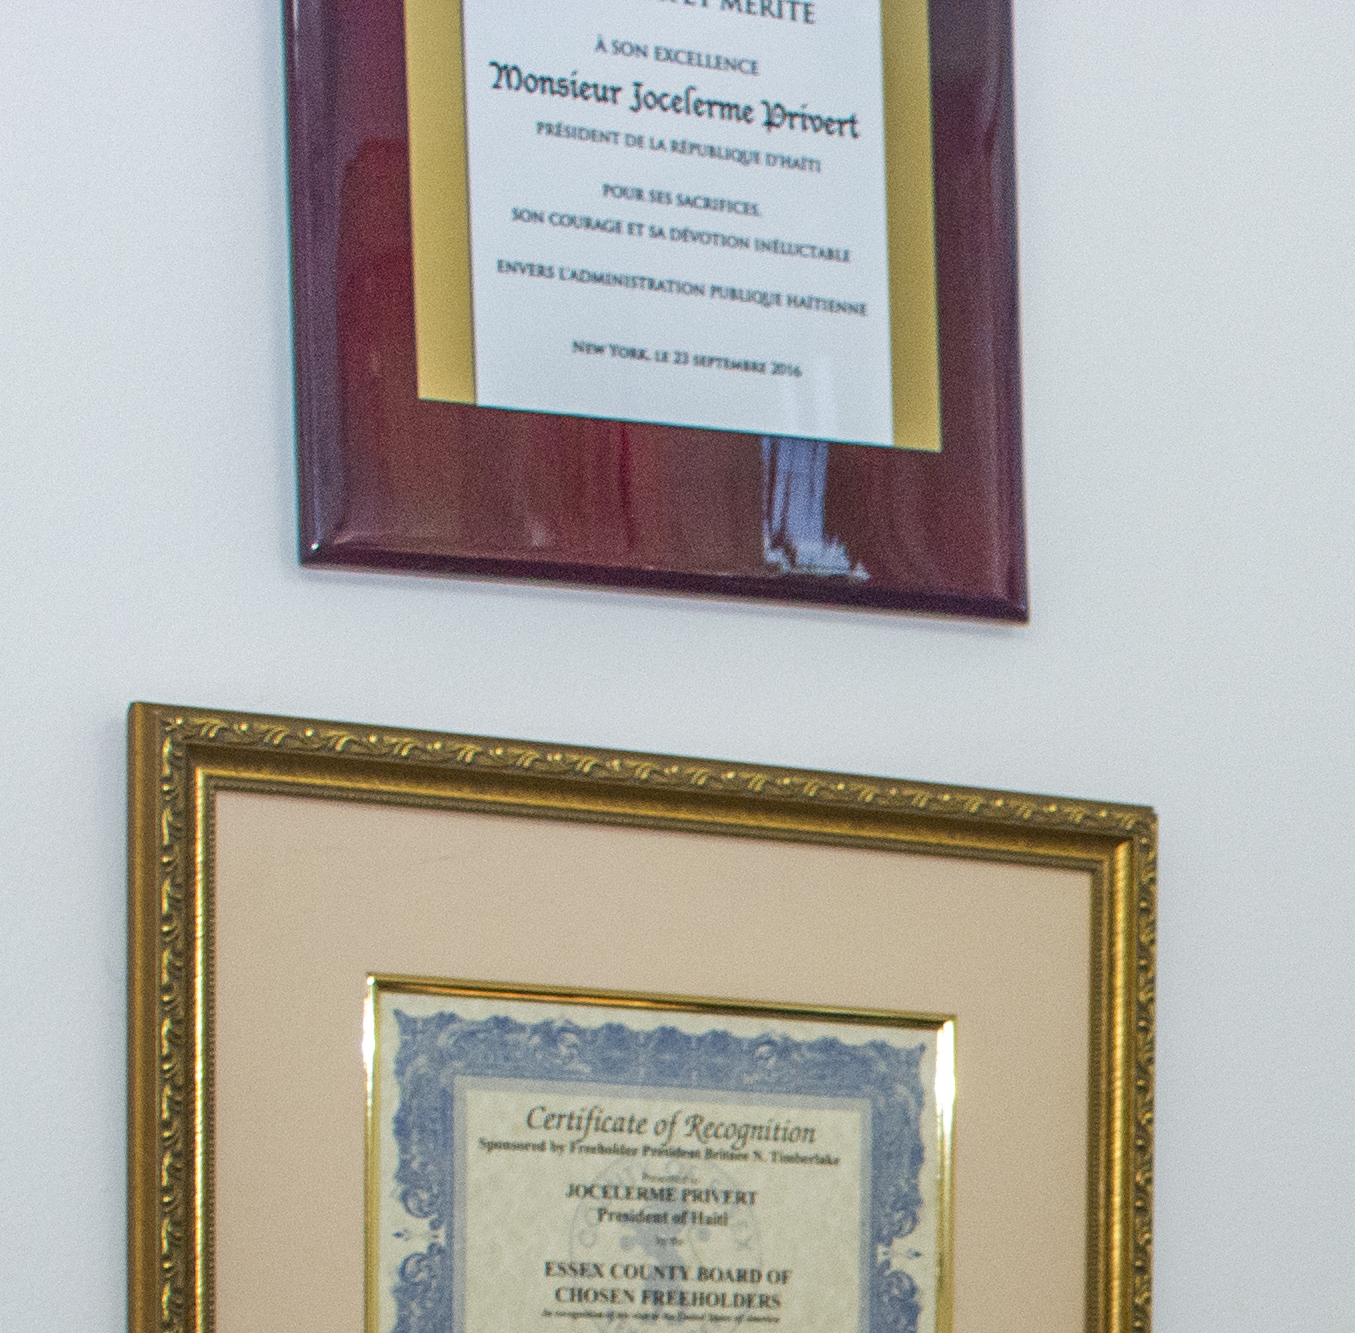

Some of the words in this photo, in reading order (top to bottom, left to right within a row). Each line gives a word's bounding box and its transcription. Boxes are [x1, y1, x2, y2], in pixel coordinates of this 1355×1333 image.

[611, 40, 649, 59] SON
[654, 46, 758, 76] EXCELLENCE
[488, 61, 623, 105] Monsieur
[629, 82, 755, 125] Jocelerme
[761, 100, 860, 140] Privert
[536, 121, 620, 145] PRÉSIDENT
[624, 132, 645, 149] DE
[649, 137, 667, 152] LA
[670, 138, 762, 167] RÉPUBLIQUE
[602, 184, 644, 202] POUR
[649, 190, 673, 206] SES
[511, 208, 545, 225] SON
[549, 212, 623, 236] COURAGE
[627, 222, 646, 238] ET
[648, 226, 667, 240] SA
[670, 226, 750, 252] DÉVOTION
[754, 240, 852, 264] INÉLUCTABLE
[496, 259, 555, 281] ENVERS
[558, 266, 706, 298] L'ADMINISTRATION
[710, 285, 783, 310] PUBLIQUE
[673, 352, 690, 367] 23
[526, 1105, 648, 1144] Certificate
[653, 1109, 682, 1147] of
[684, 1113, 816, 1151] Recognition
[478, 1137, 546, 1154] Sponsored
[549, 1140, 566, 1156] by
[565, 1183, 677, 1203] JOCELERME
[681, 1187, 759, 1206] PRIVERT
[597, 1207, 670, 1225] President
[671, 1210, 688, 1225] of
[544, 1260, 604, 1280] ESSEX
[609, 1263, 691, 1282] COUNTY
[697, 1266, 763, 1285] BOARD
[766, 1268, 793, 1286] OF
[554, 1286, 635, 1304] CHOSEN
[641, 1288, 782, 1309] FREEHOLDERS
